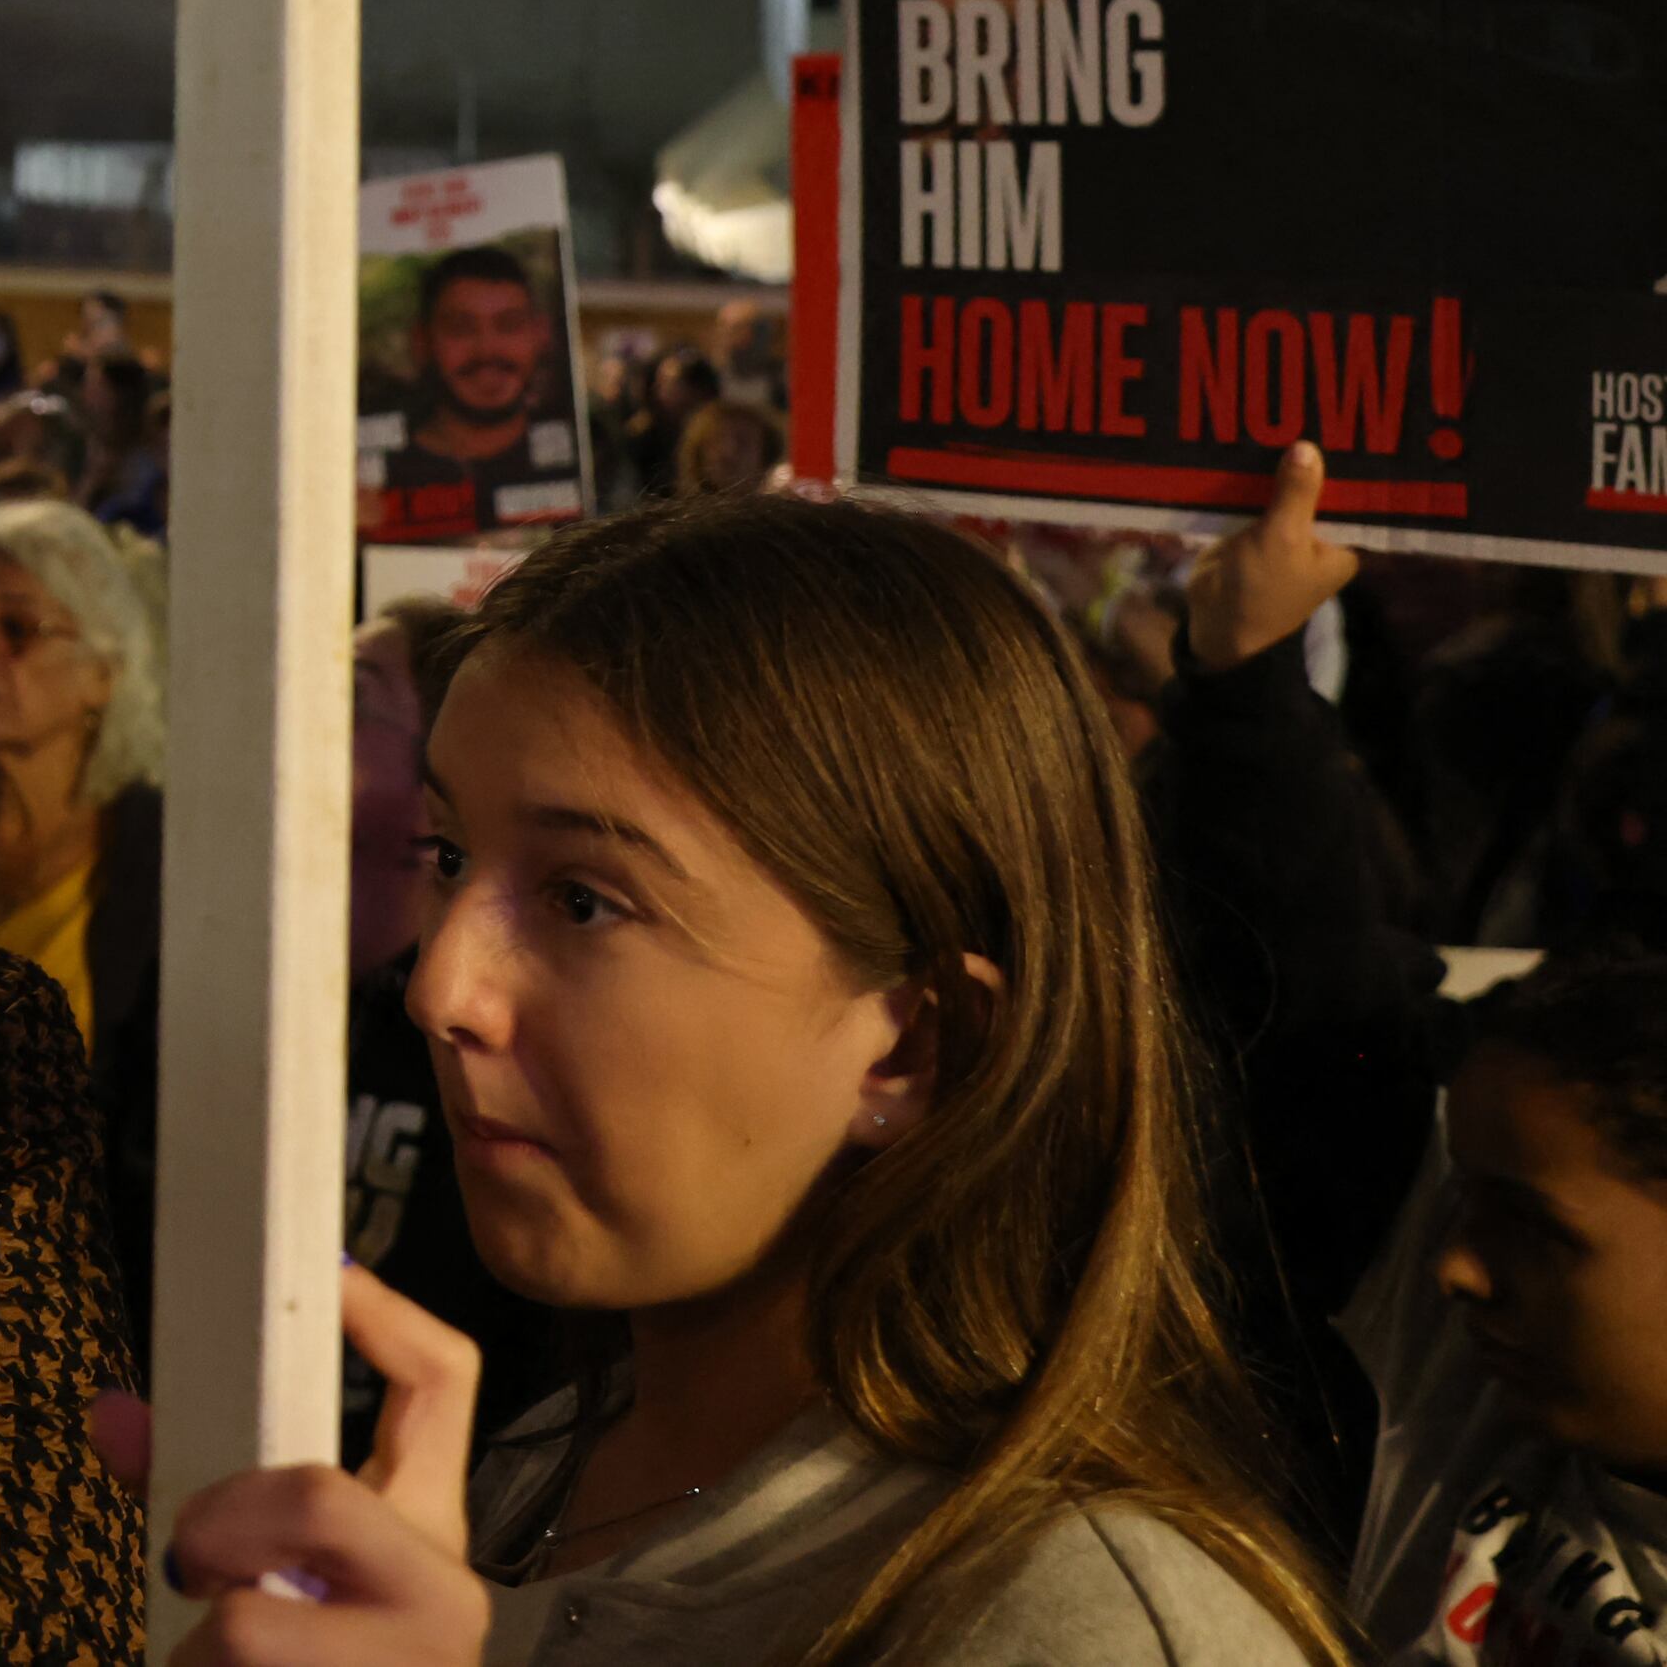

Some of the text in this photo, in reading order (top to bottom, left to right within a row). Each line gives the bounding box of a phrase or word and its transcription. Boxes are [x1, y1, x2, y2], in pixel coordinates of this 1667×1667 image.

[898, 140, 1063, 273] HIM
[898, 293, 1464, 460] HOME NOW!
[1591, 370, 1667, 424] HOS
